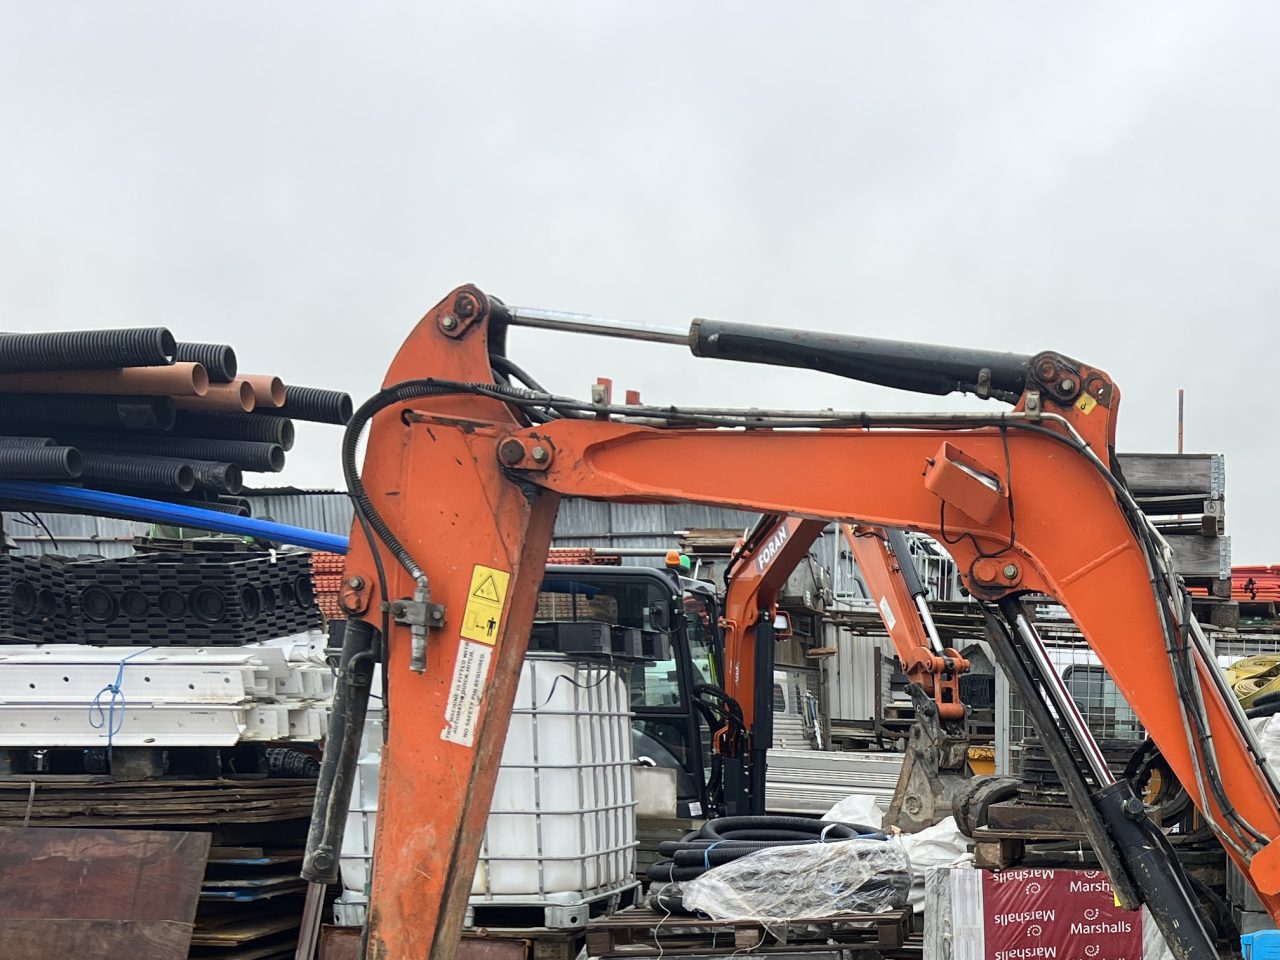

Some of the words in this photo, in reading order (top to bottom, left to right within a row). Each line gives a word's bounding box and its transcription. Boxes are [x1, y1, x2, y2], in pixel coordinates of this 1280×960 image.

[758, 526, 787, 570] FORAN
[458, 660, 466, 684] FITTED
[465, 701, 475, 726] SAFETY
[463, 729, 469, 738] NO
[993, 870, 1054, 883] Marshalls
[1069, 880, 1114, 893] Marsh
[994, 909, 1055, 926] Marshalls
[1070, 920, 1132, 935] Marshalls
